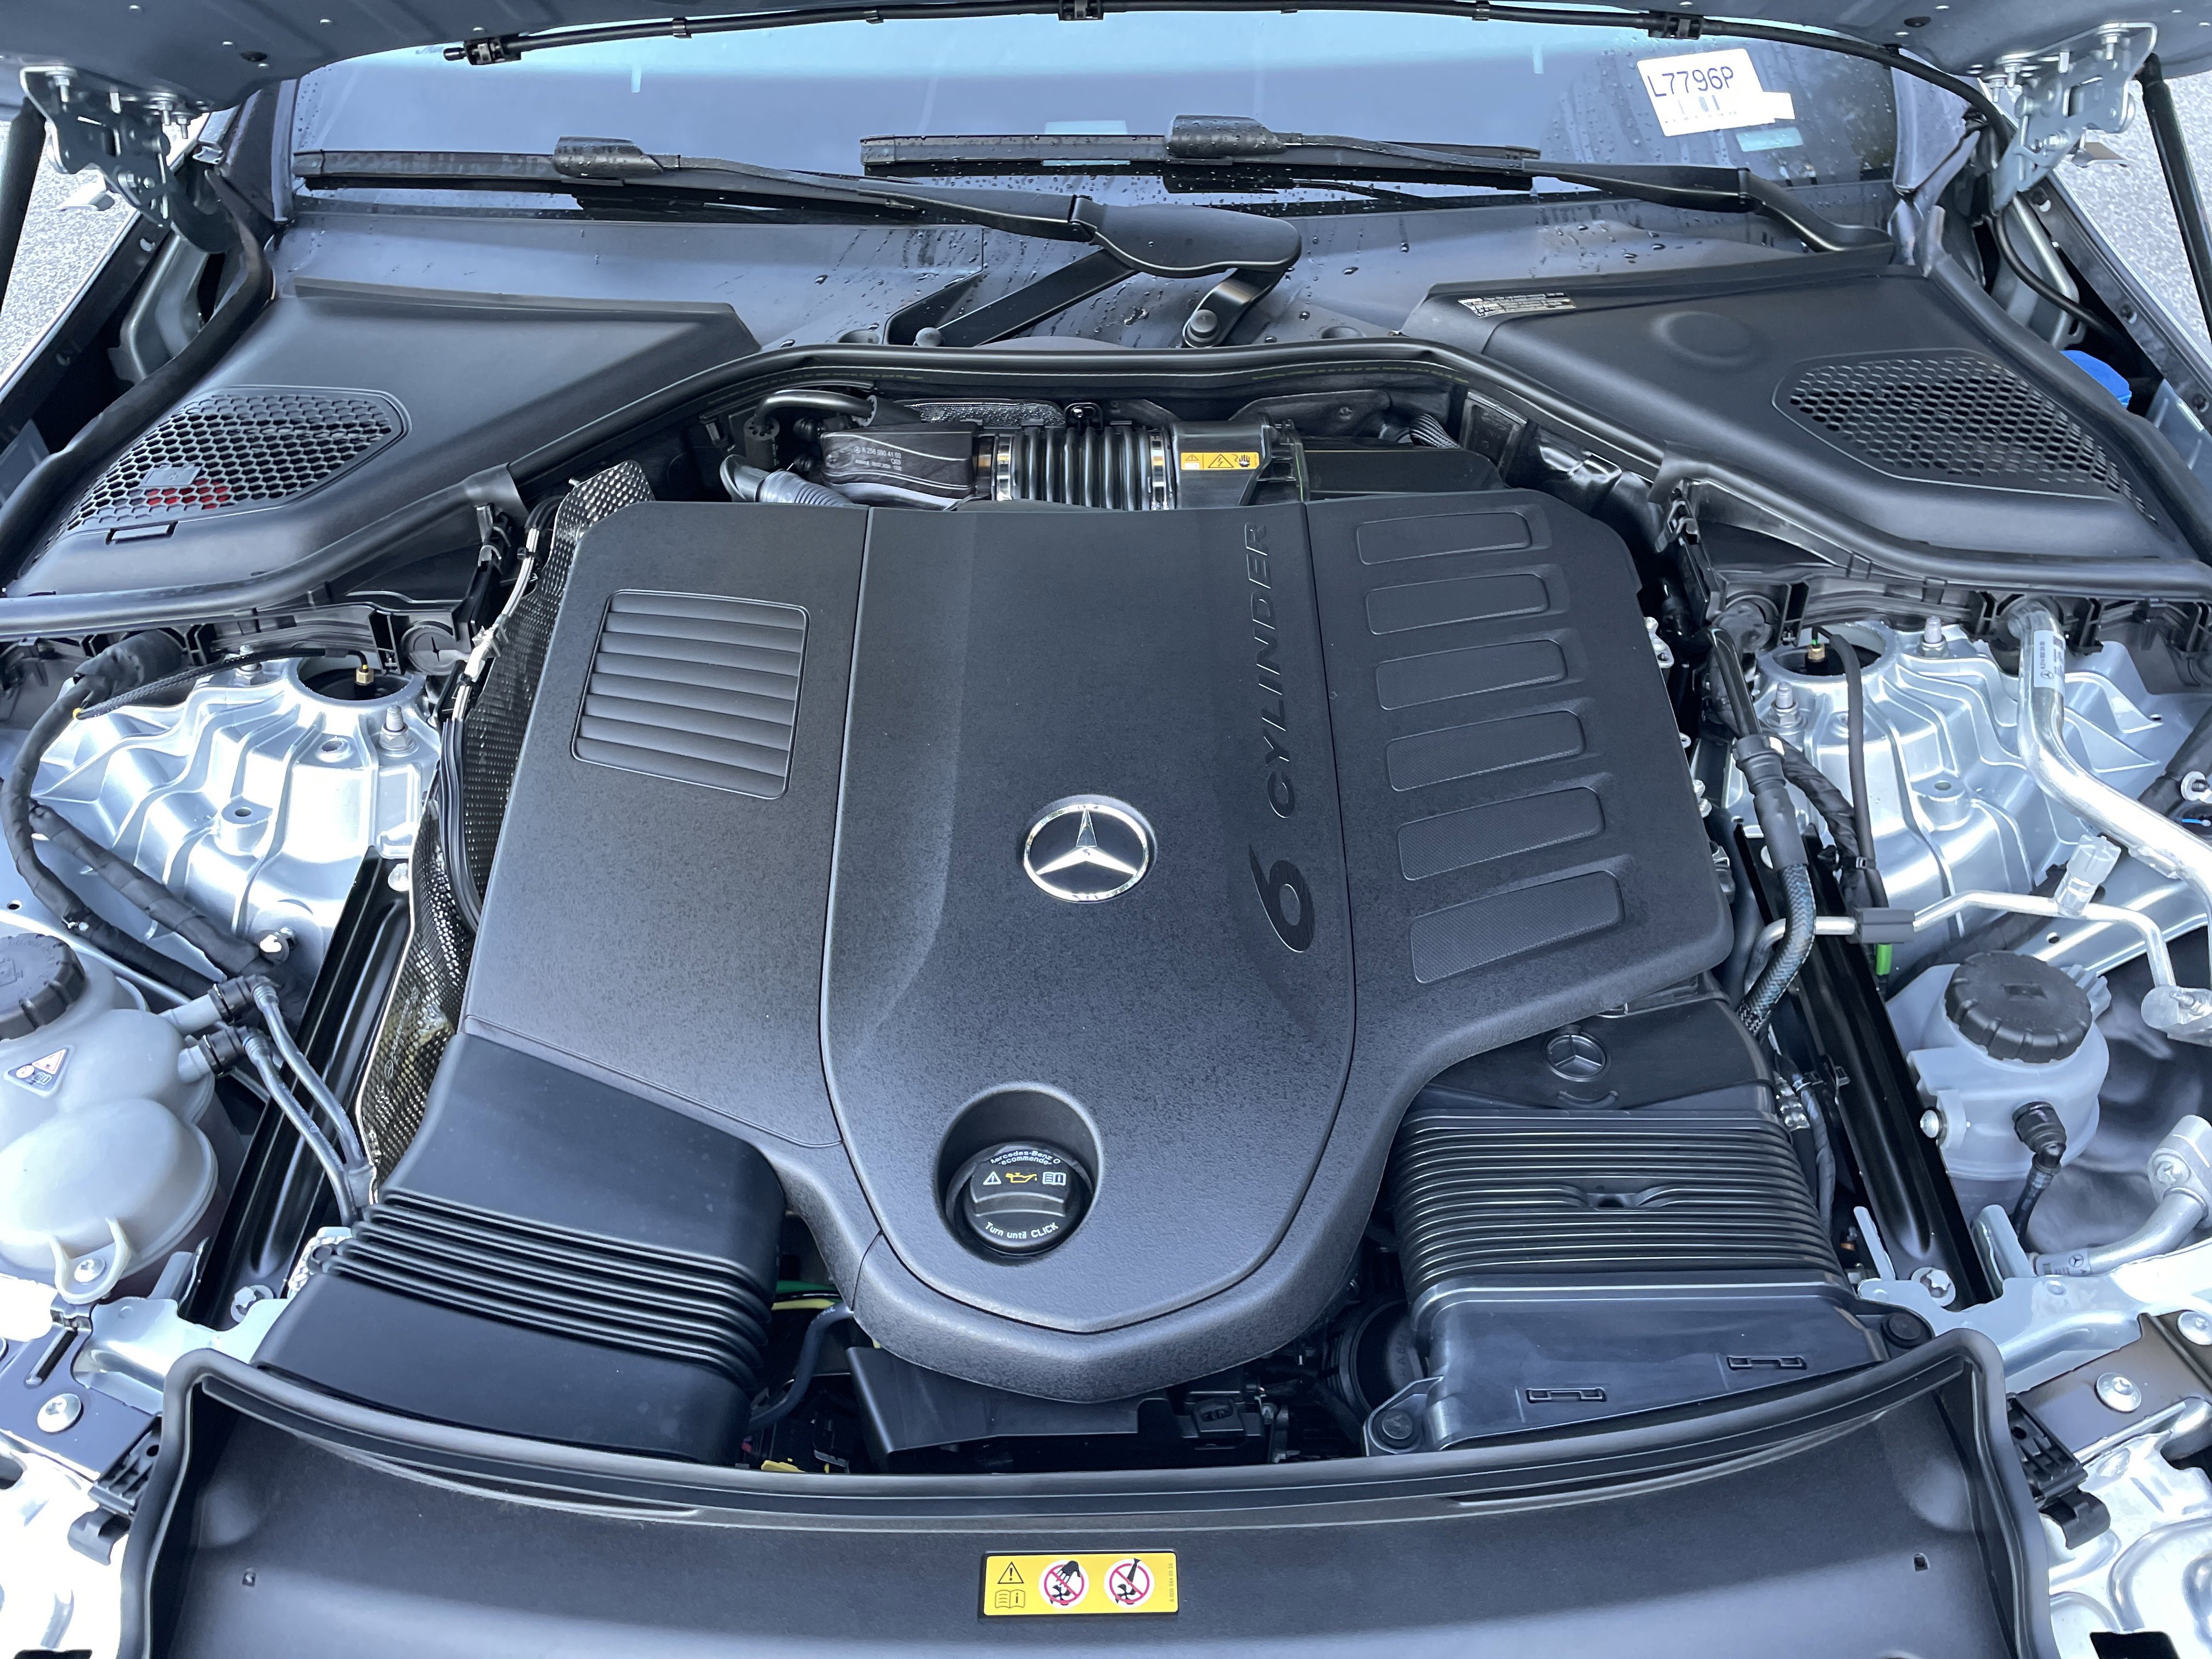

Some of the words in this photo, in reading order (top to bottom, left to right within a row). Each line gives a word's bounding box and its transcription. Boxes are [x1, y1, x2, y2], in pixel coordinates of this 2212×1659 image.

[1647, 66, 1734, 97] L7796P
[1244, 521, 1296, 819] CYLINDER
[1248, 843, 1316, 953] 6
[998, 1155, 1053, 1166] ecommende
[985, 1222, 1004, 1237] Turn
[1006, 1231, 1027, 1239] until
[1030, 1222, 1059, 1238] CLICK
